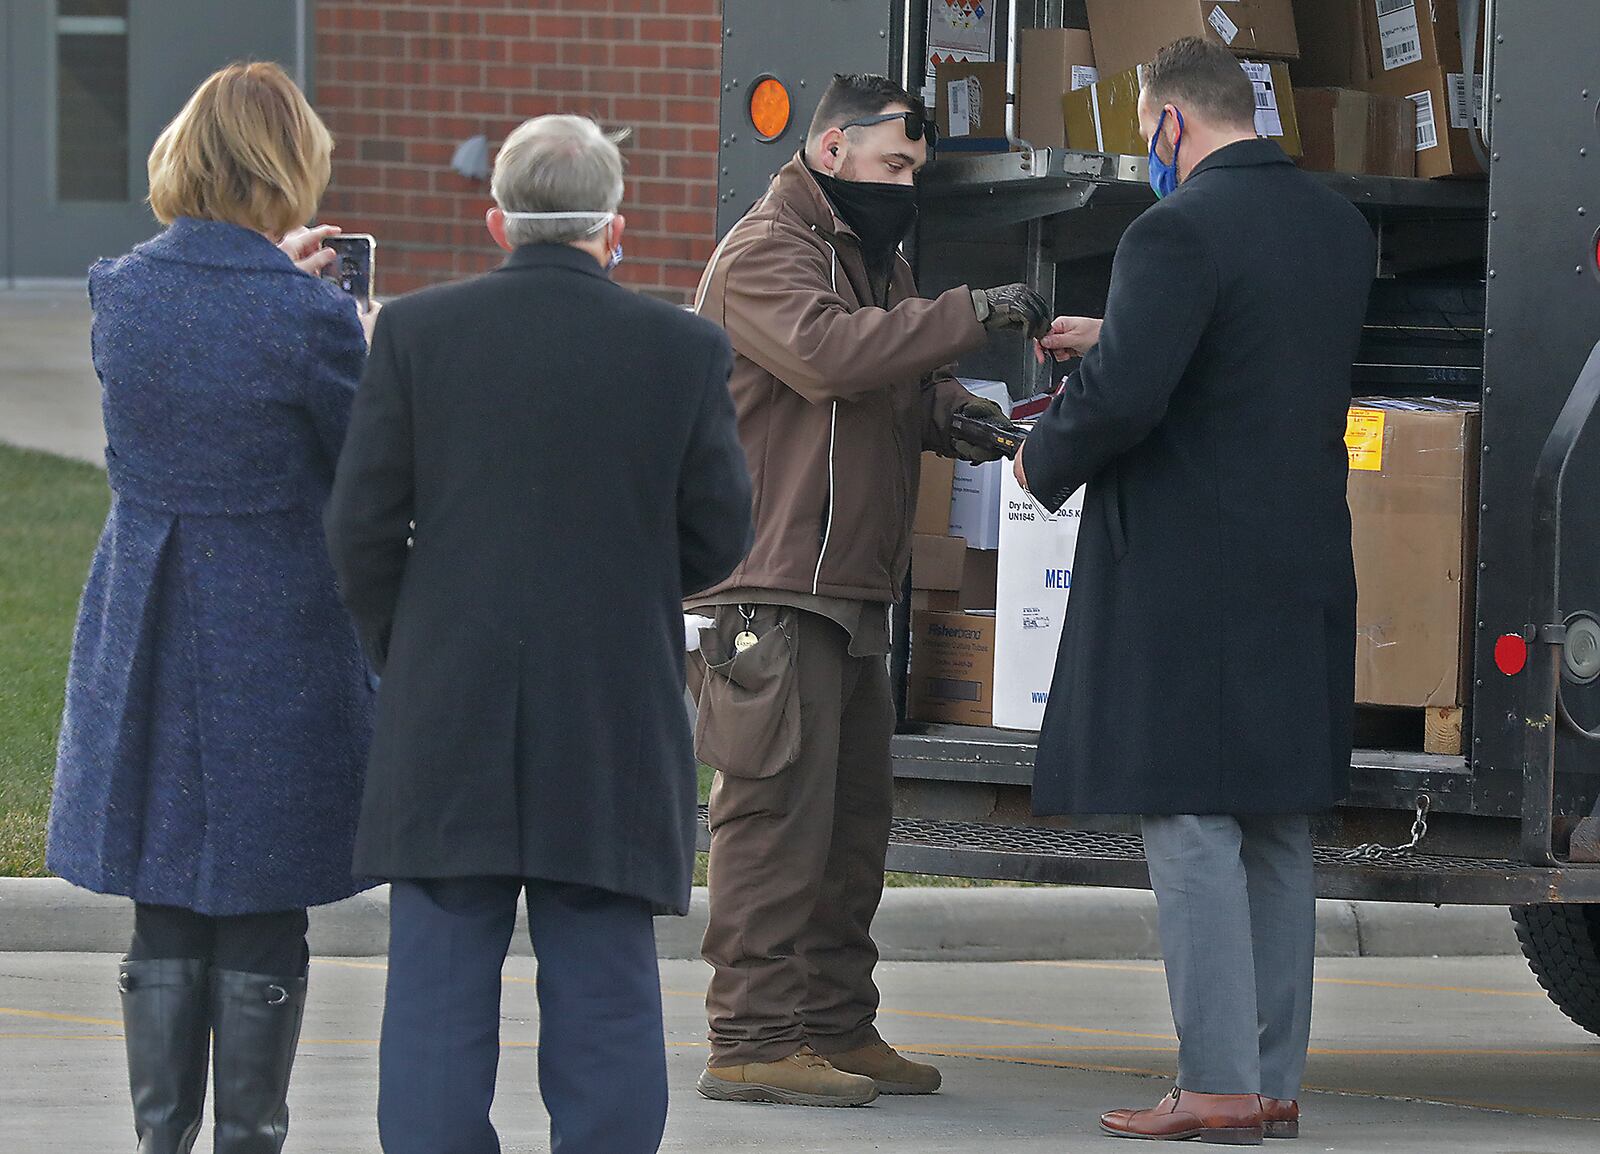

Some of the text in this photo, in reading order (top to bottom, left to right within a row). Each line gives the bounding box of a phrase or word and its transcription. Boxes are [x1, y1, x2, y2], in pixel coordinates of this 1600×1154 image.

[1009, 501, 1033, 511] Dry Ice
[1009, 512, 1035, 521] UN1845
[1045, 569, 1072, 588] MED
[928, 623, 981, 640] Fisherbrand
